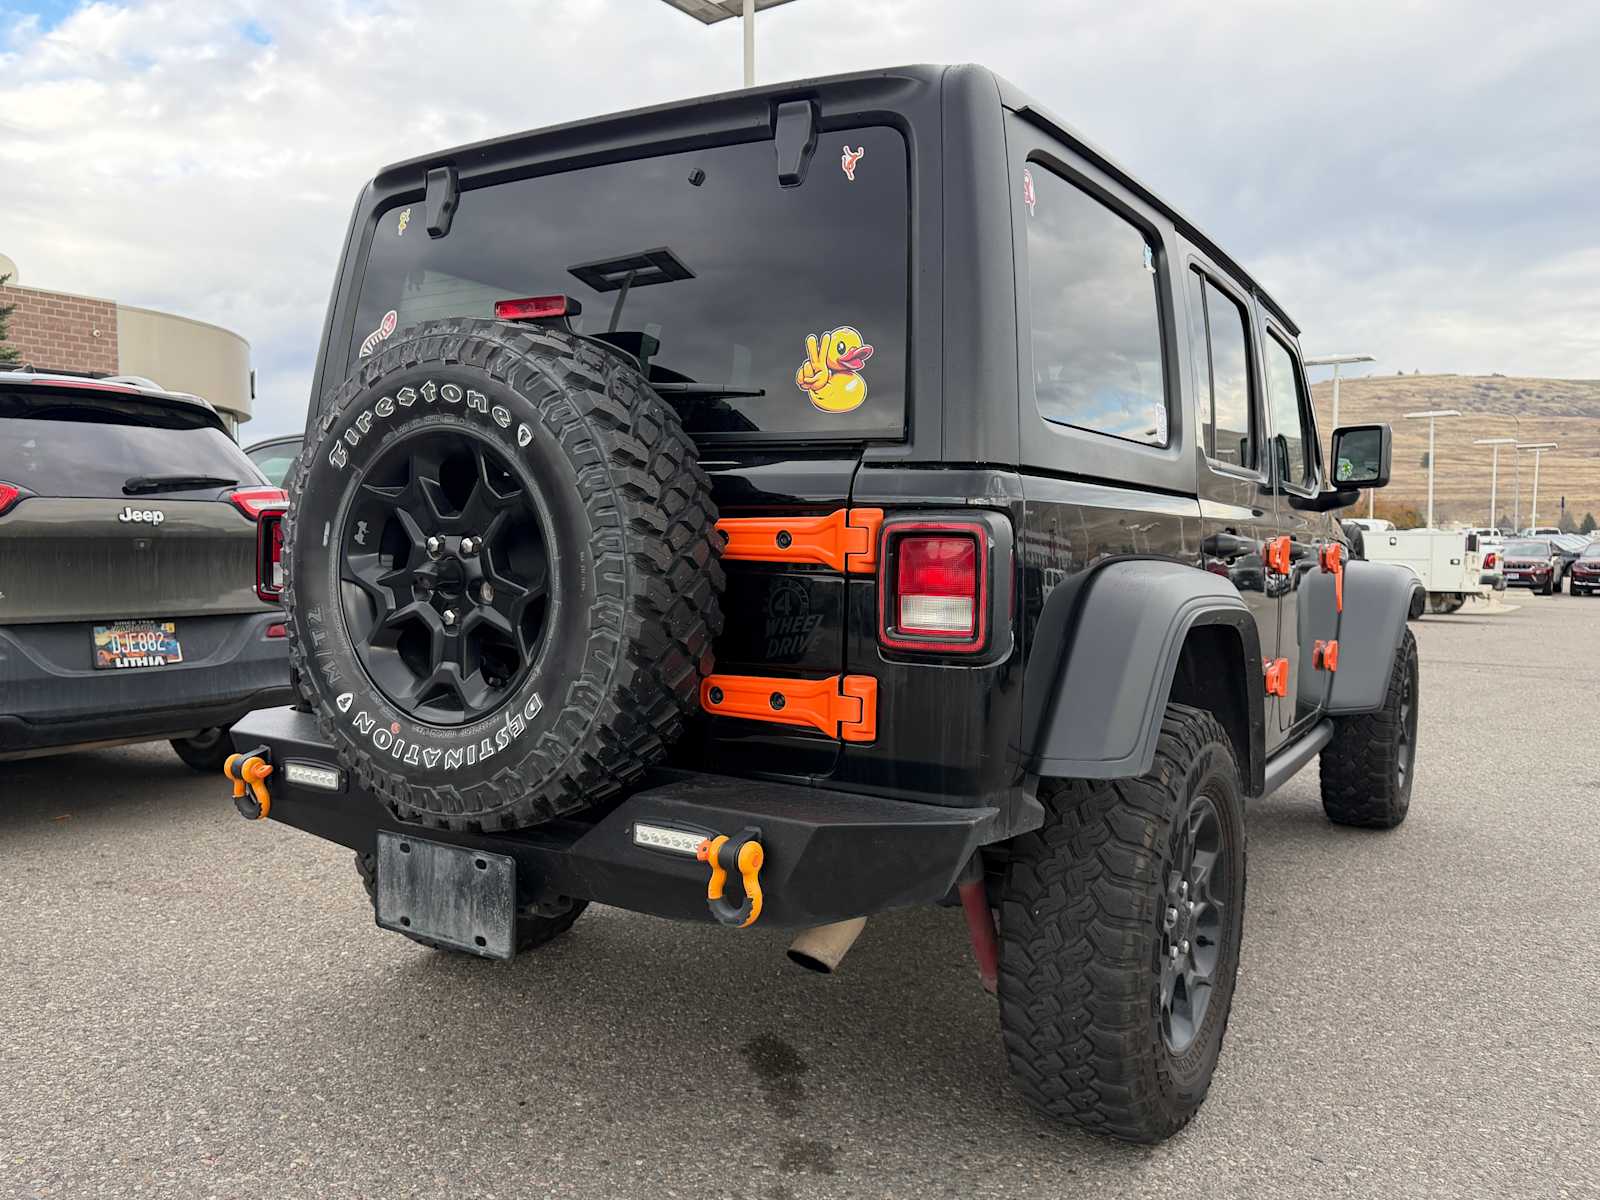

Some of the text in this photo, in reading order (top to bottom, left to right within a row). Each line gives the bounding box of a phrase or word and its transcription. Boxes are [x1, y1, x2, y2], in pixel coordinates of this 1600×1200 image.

[329, 380, 513, 470] Firestone
[118, 507, 164, 525] Jeep
[115, 655, 165, 668] LITHIA
[353, 693, 545, 770] DESTINATION
